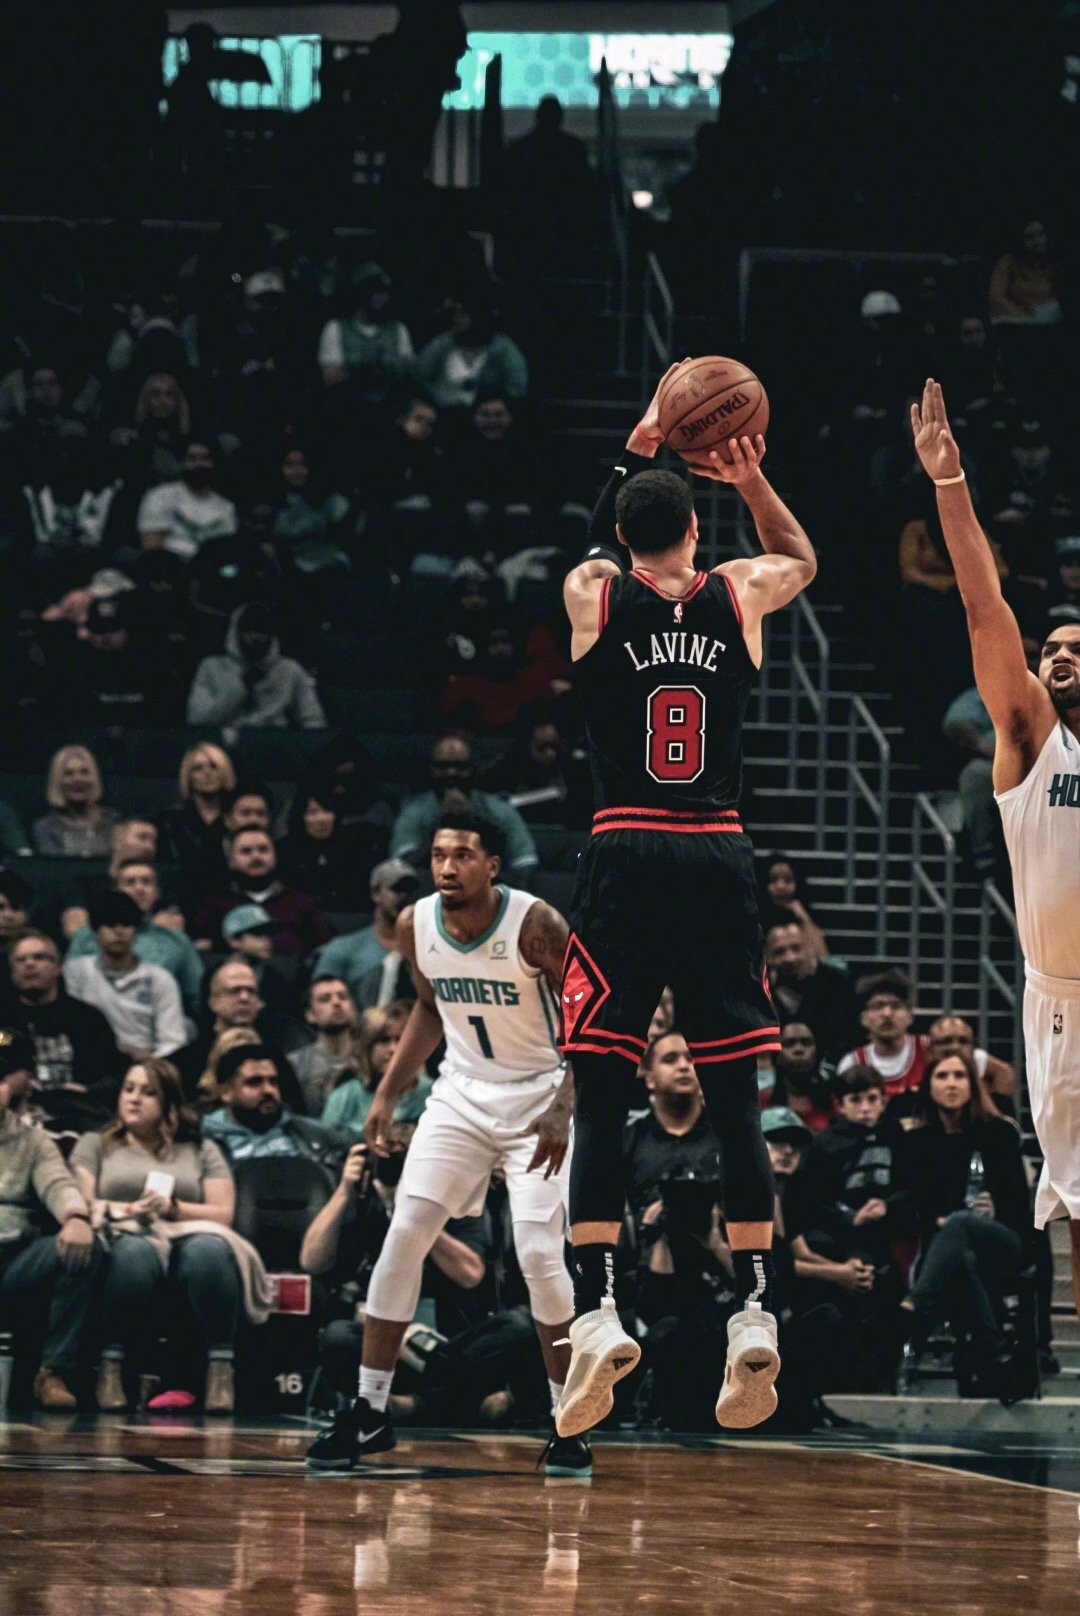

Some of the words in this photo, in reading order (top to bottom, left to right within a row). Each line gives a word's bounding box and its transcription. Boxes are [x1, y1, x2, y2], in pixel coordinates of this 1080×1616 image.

[623, 632, 727, 672] LAVINE
[646, 685, 706, 784] 8
[467, 1015, 495, 1059] 1
[273, 1373, 303, 1394] 16
